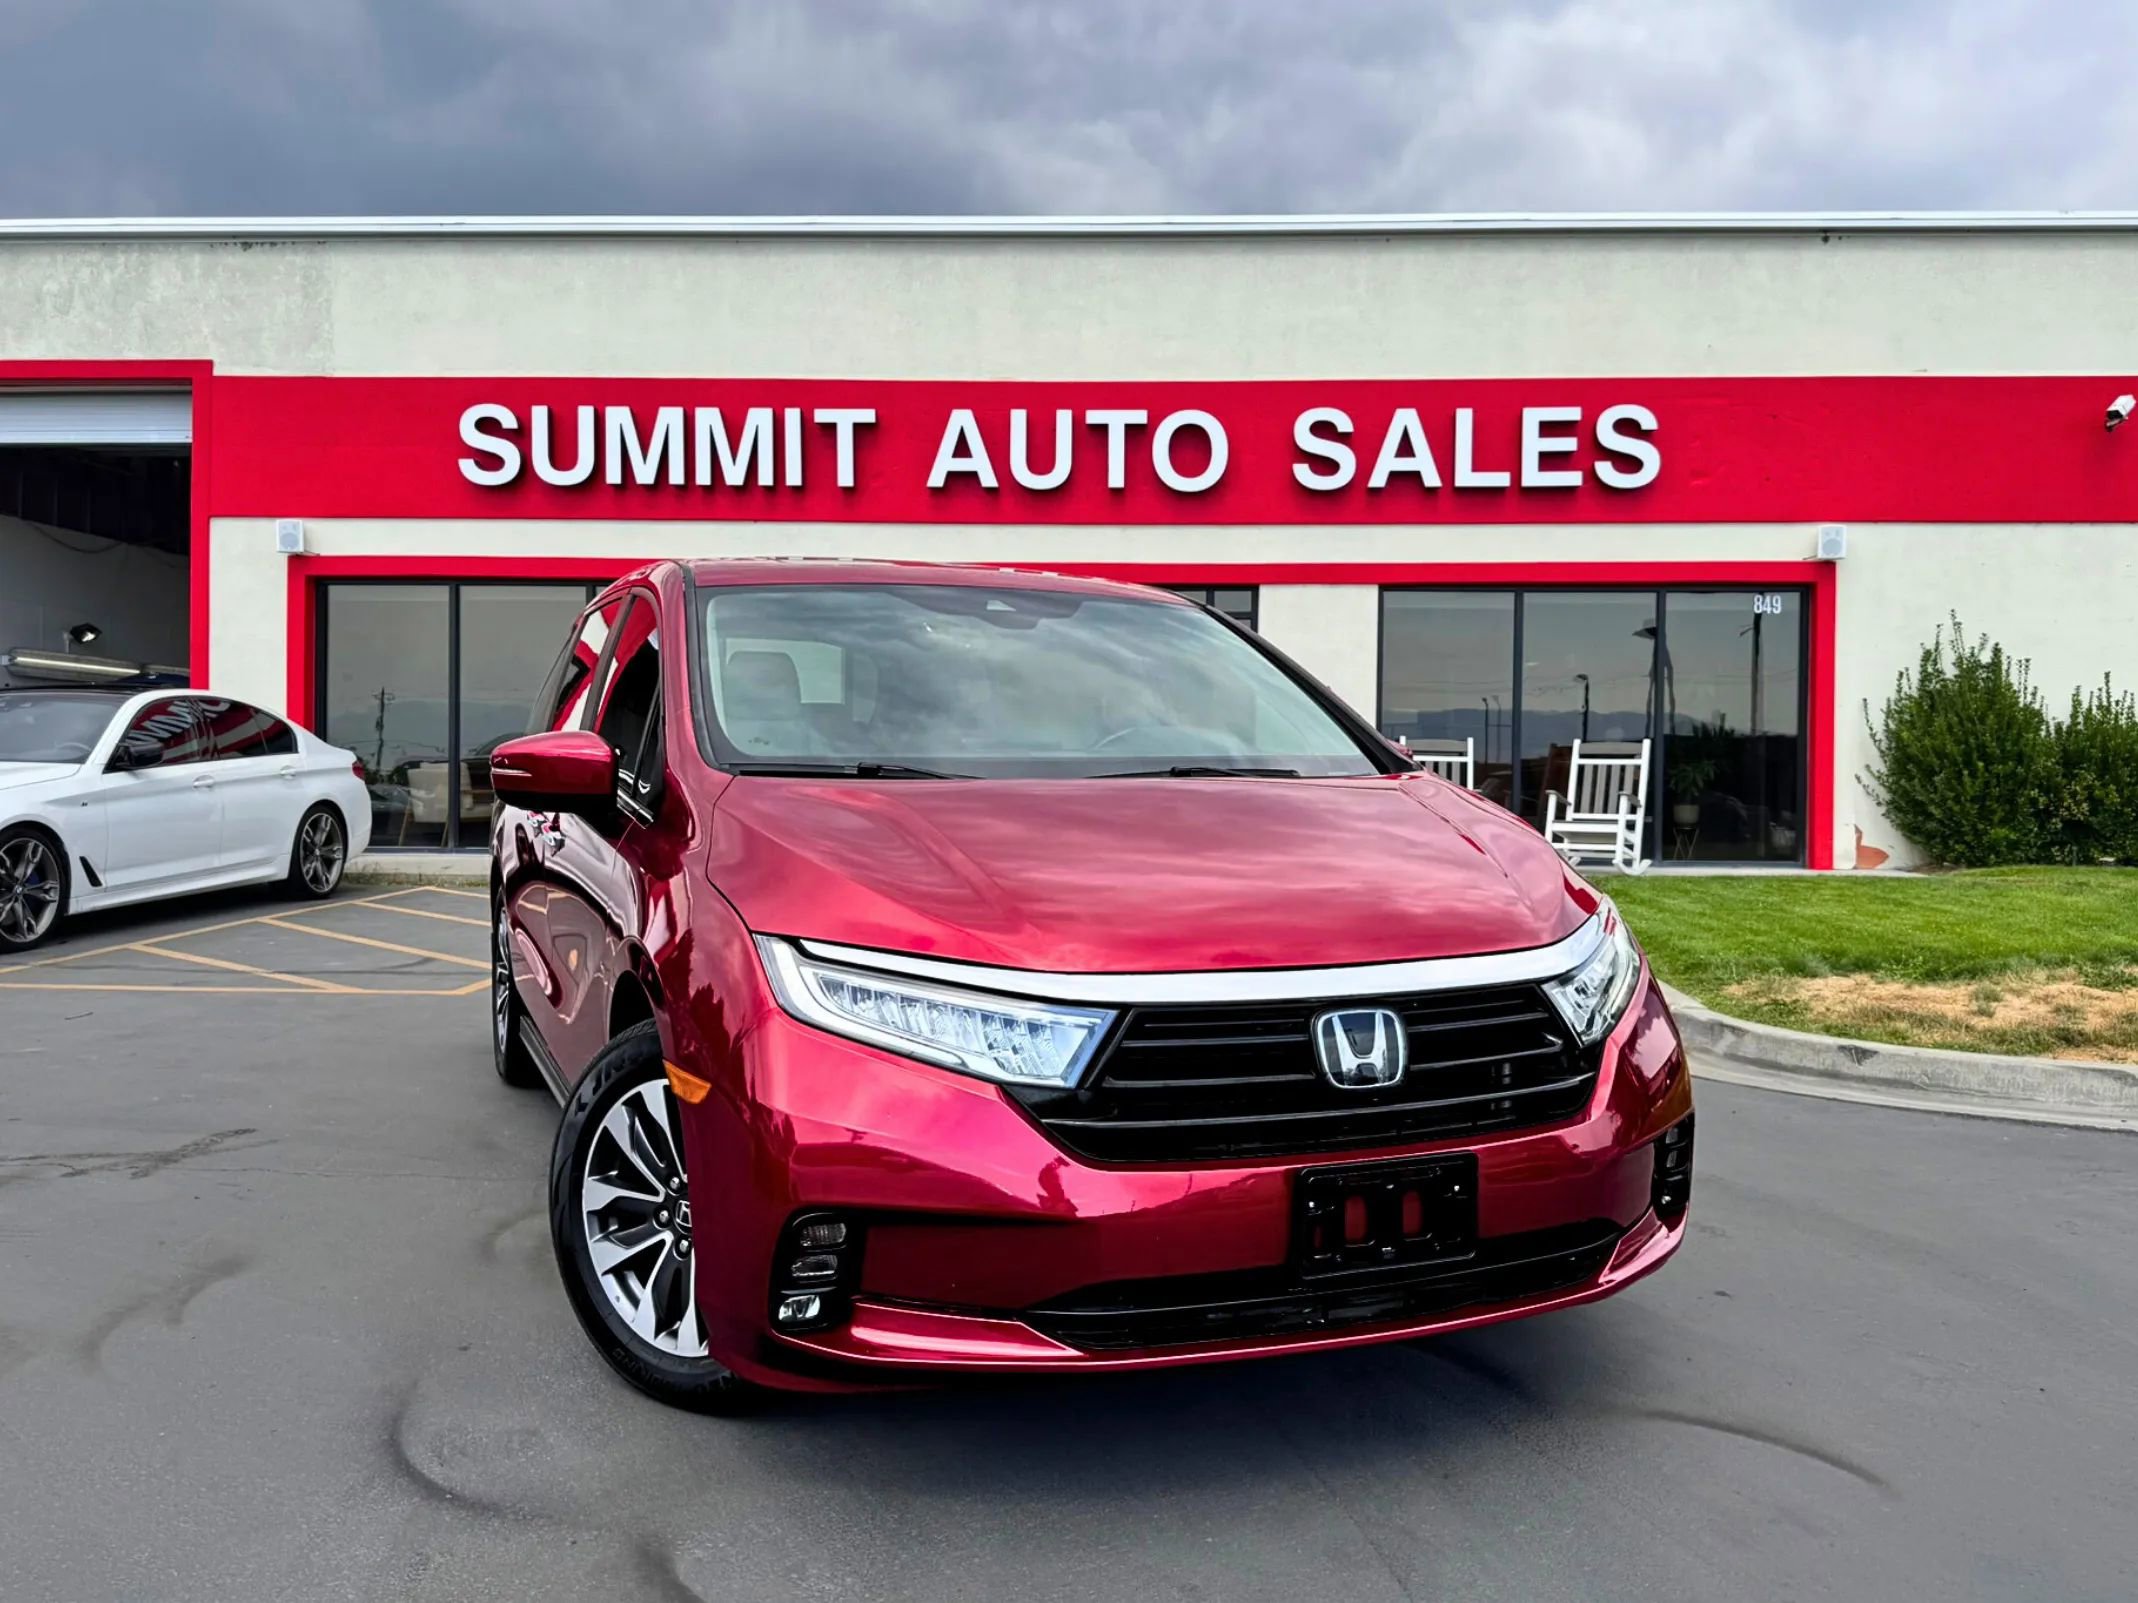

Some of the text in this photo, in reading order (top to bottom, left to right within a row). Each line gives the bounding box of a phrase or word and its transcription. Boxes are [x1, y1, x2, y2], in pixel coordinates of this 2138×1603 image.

[458, 403, 1662, 493] SUMMIT AUTO SALES
[1753, 594, 1782, 614] 849
